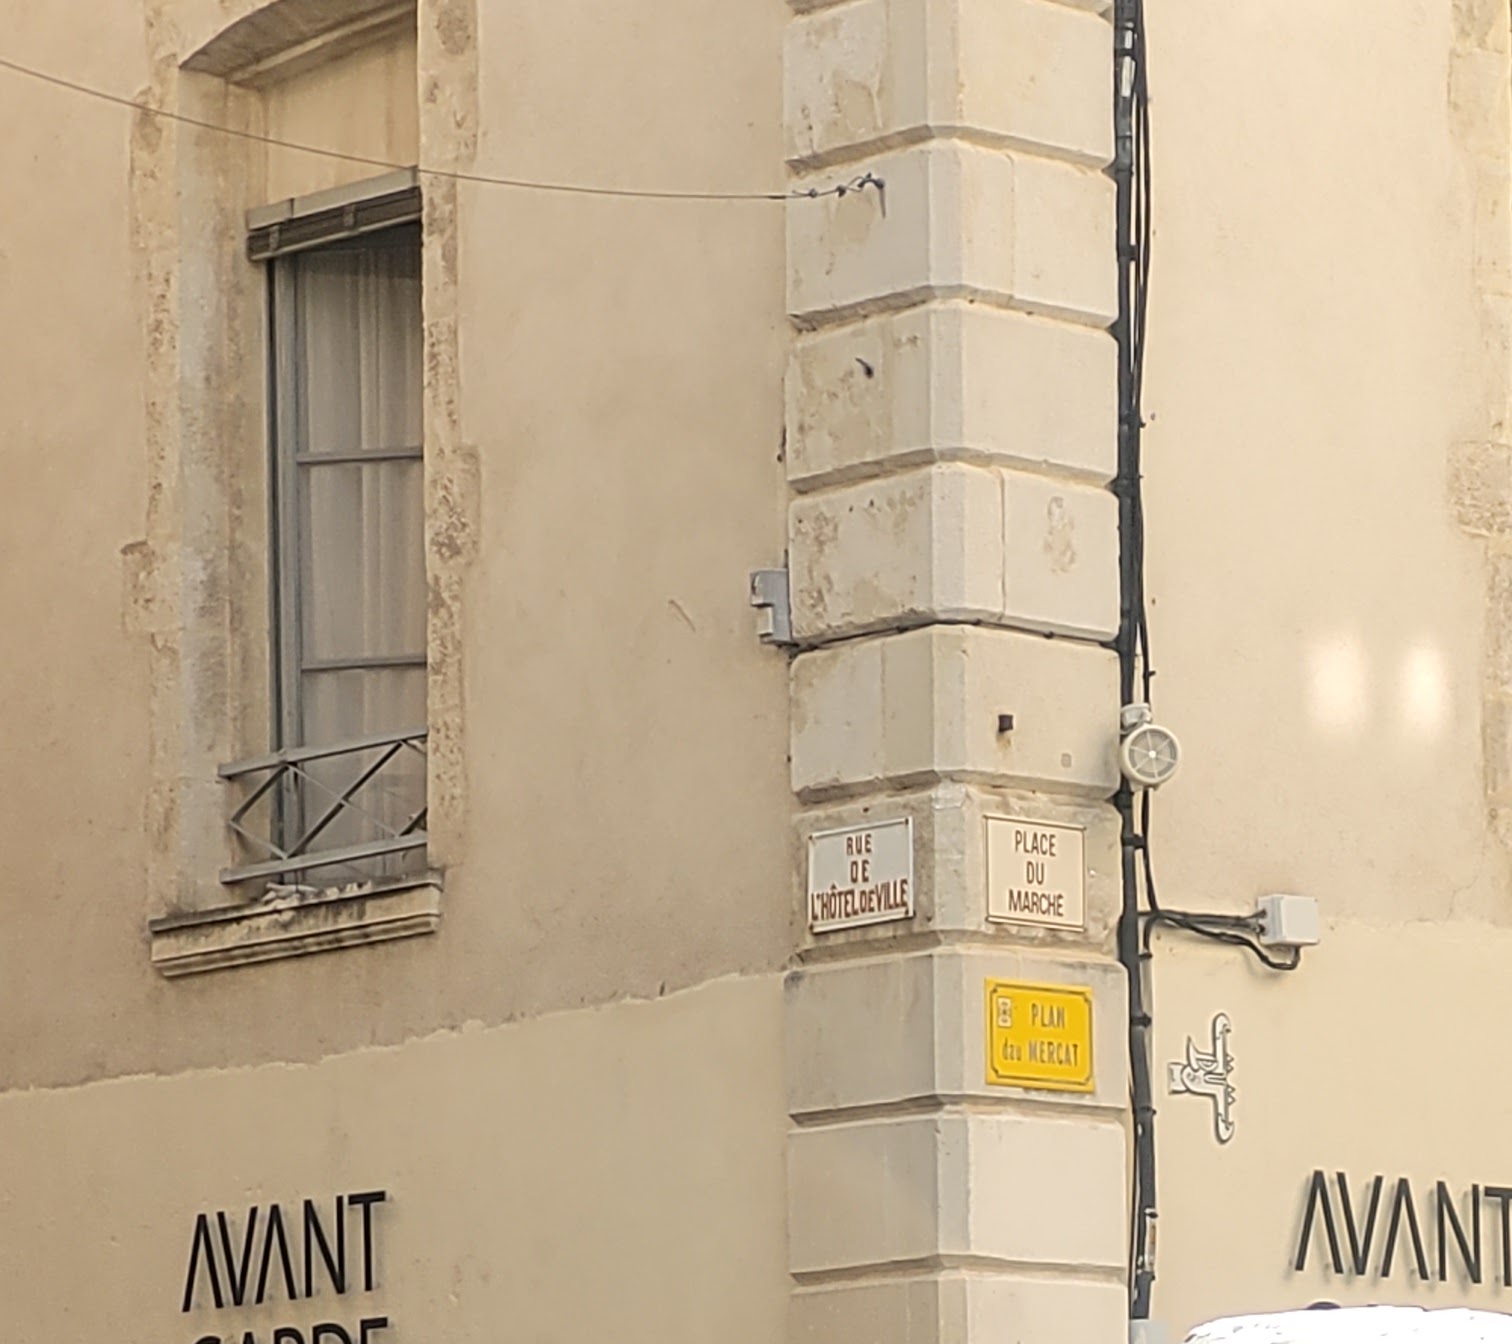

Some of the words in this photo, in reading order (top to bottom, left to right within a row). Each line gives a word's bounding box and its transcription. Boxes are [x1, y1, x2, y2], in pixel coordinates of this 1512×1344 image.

[847, 833, 872, 855] RUE
[1015, 829, 1056, 857] PLACE
[851, 859, 870, 883] DE
[1026, 861, 1044, 885] DU
[1031, 1002, 1065, 1029] PLAN
[1028, 1040, 1078, 1067] MERCAT
[182, 1190, 386, 1312] AVANT
